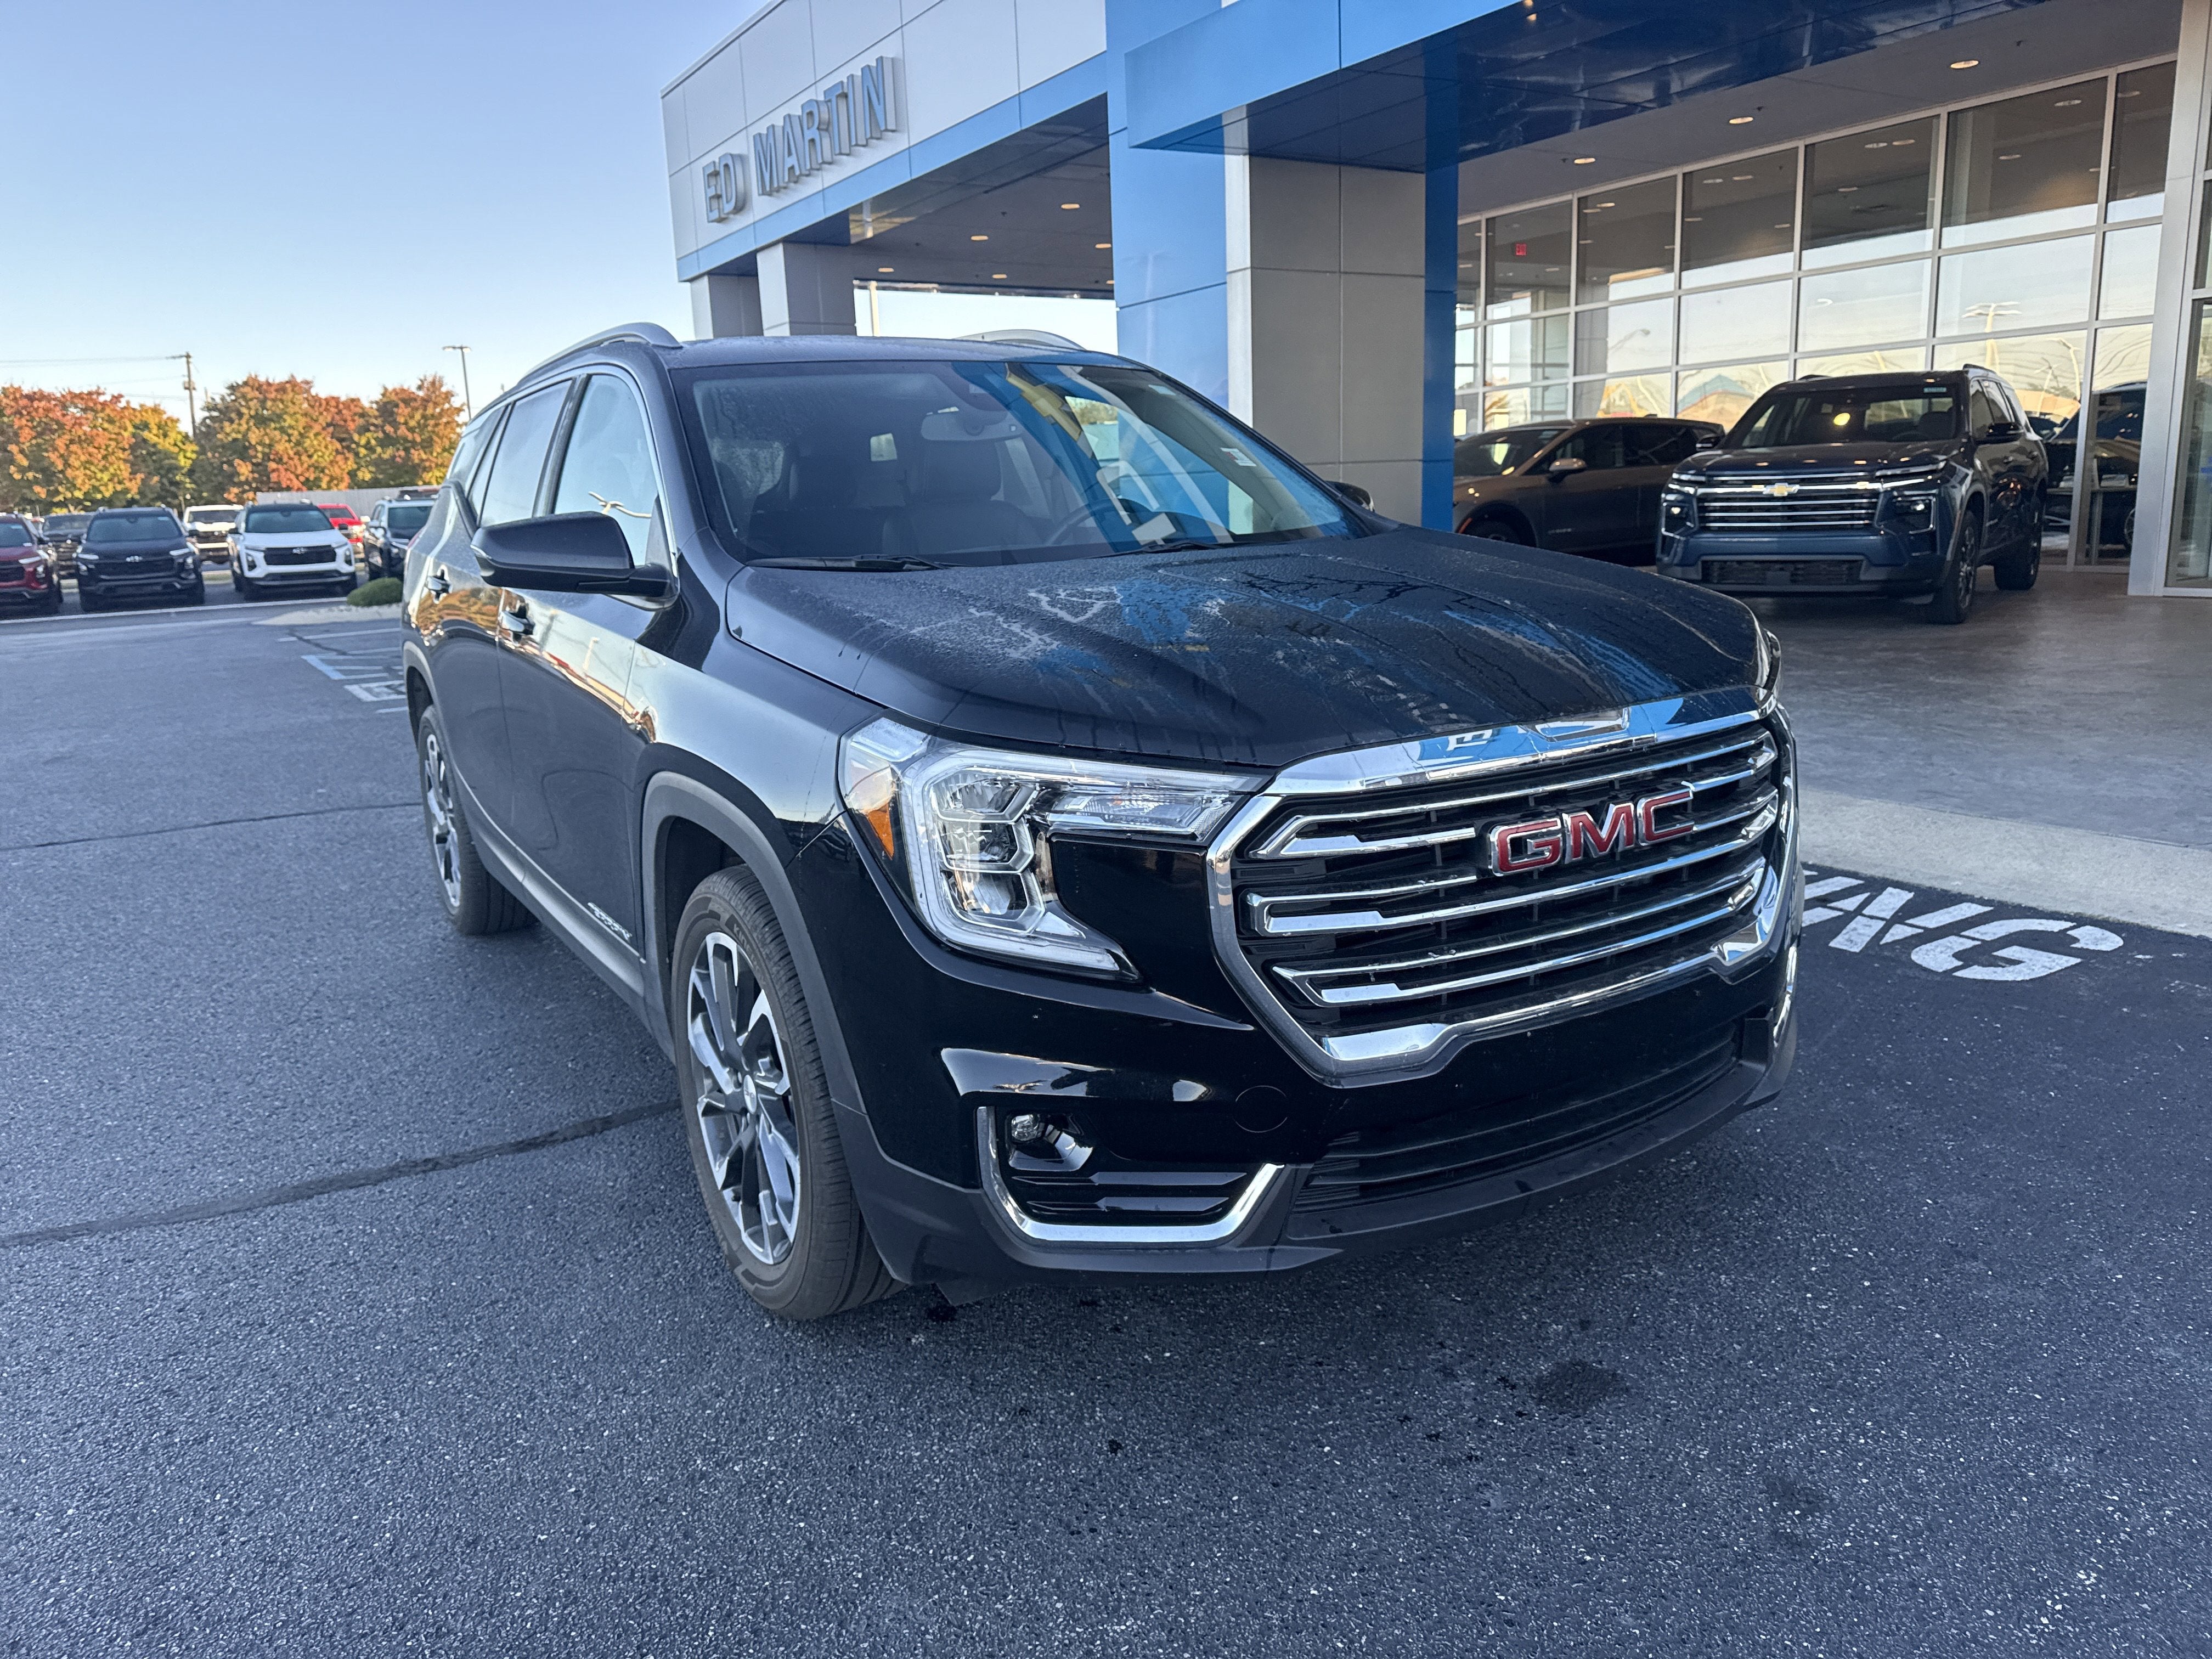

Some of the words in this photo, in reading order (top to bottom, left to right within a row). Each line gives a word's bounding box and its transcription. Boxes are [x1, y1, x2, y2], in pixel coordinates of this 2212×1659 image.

[702, 153, 747, 223] ED
[753, 55, 896, 196] MARTIN
[1489, 788, 1694, 877] GMC
